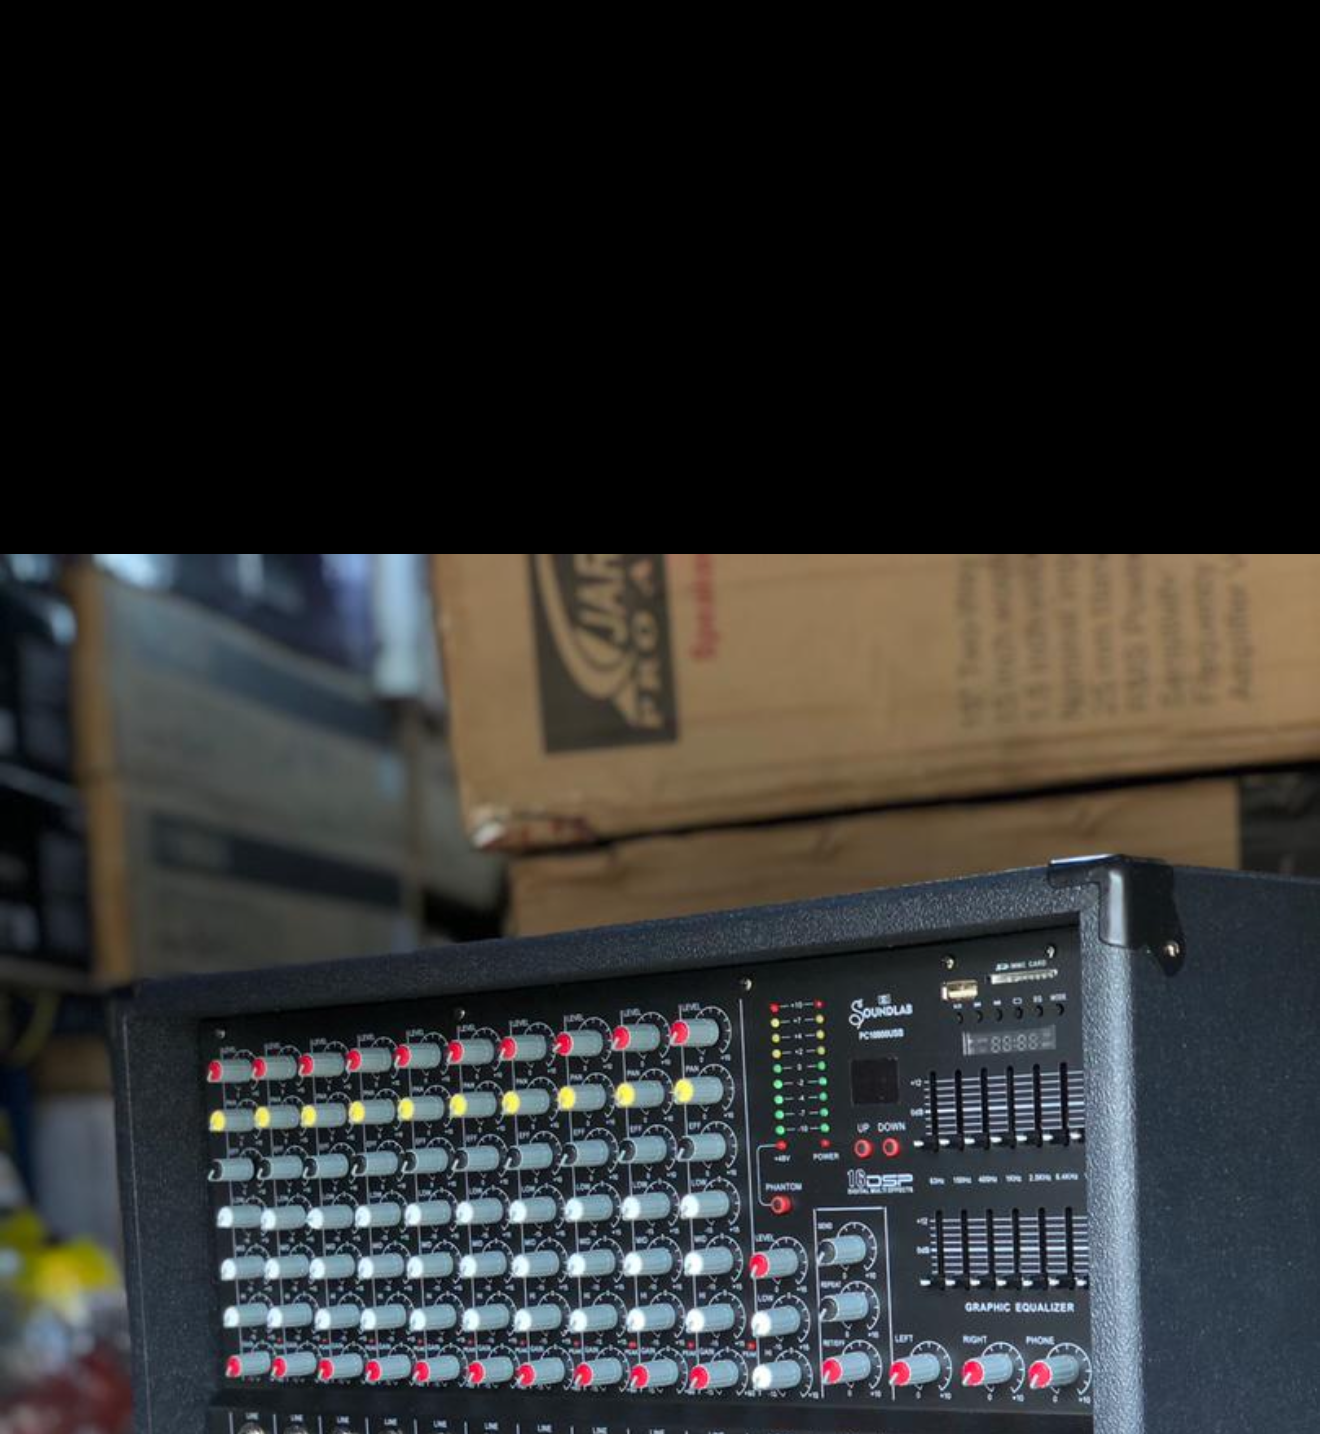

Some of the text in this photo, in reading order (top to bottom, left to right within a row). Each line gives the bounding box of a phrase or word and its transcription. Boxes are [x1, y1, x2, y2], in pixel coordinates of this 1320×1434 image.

[849, 998, 913, 1029] SOUNDLAB
[857, 1124, 870, 1132] UP
[878, 1122, 906, 1131] DOWN
[813, 1153, 839, 1161] POWER
[766, 1182, 802, 1191] PHANTOM
[756, 1233, 774, 1242] LEVEL
[757, 1294, 774, 1302] LOW
[965, 1302, 1075, 1312] GRAPHIC EQUALIZER
[894, 1334, 913, 1343] LEFT
[962, 1335, 988, 1344] RIGHT
[1026, 1336, 1055, 1345] PHONE
[484, 1422, 498, 1430] LINE
[537, 1424, 552, 1433] LINE
[592, 1427, 608, 1434] LINE
